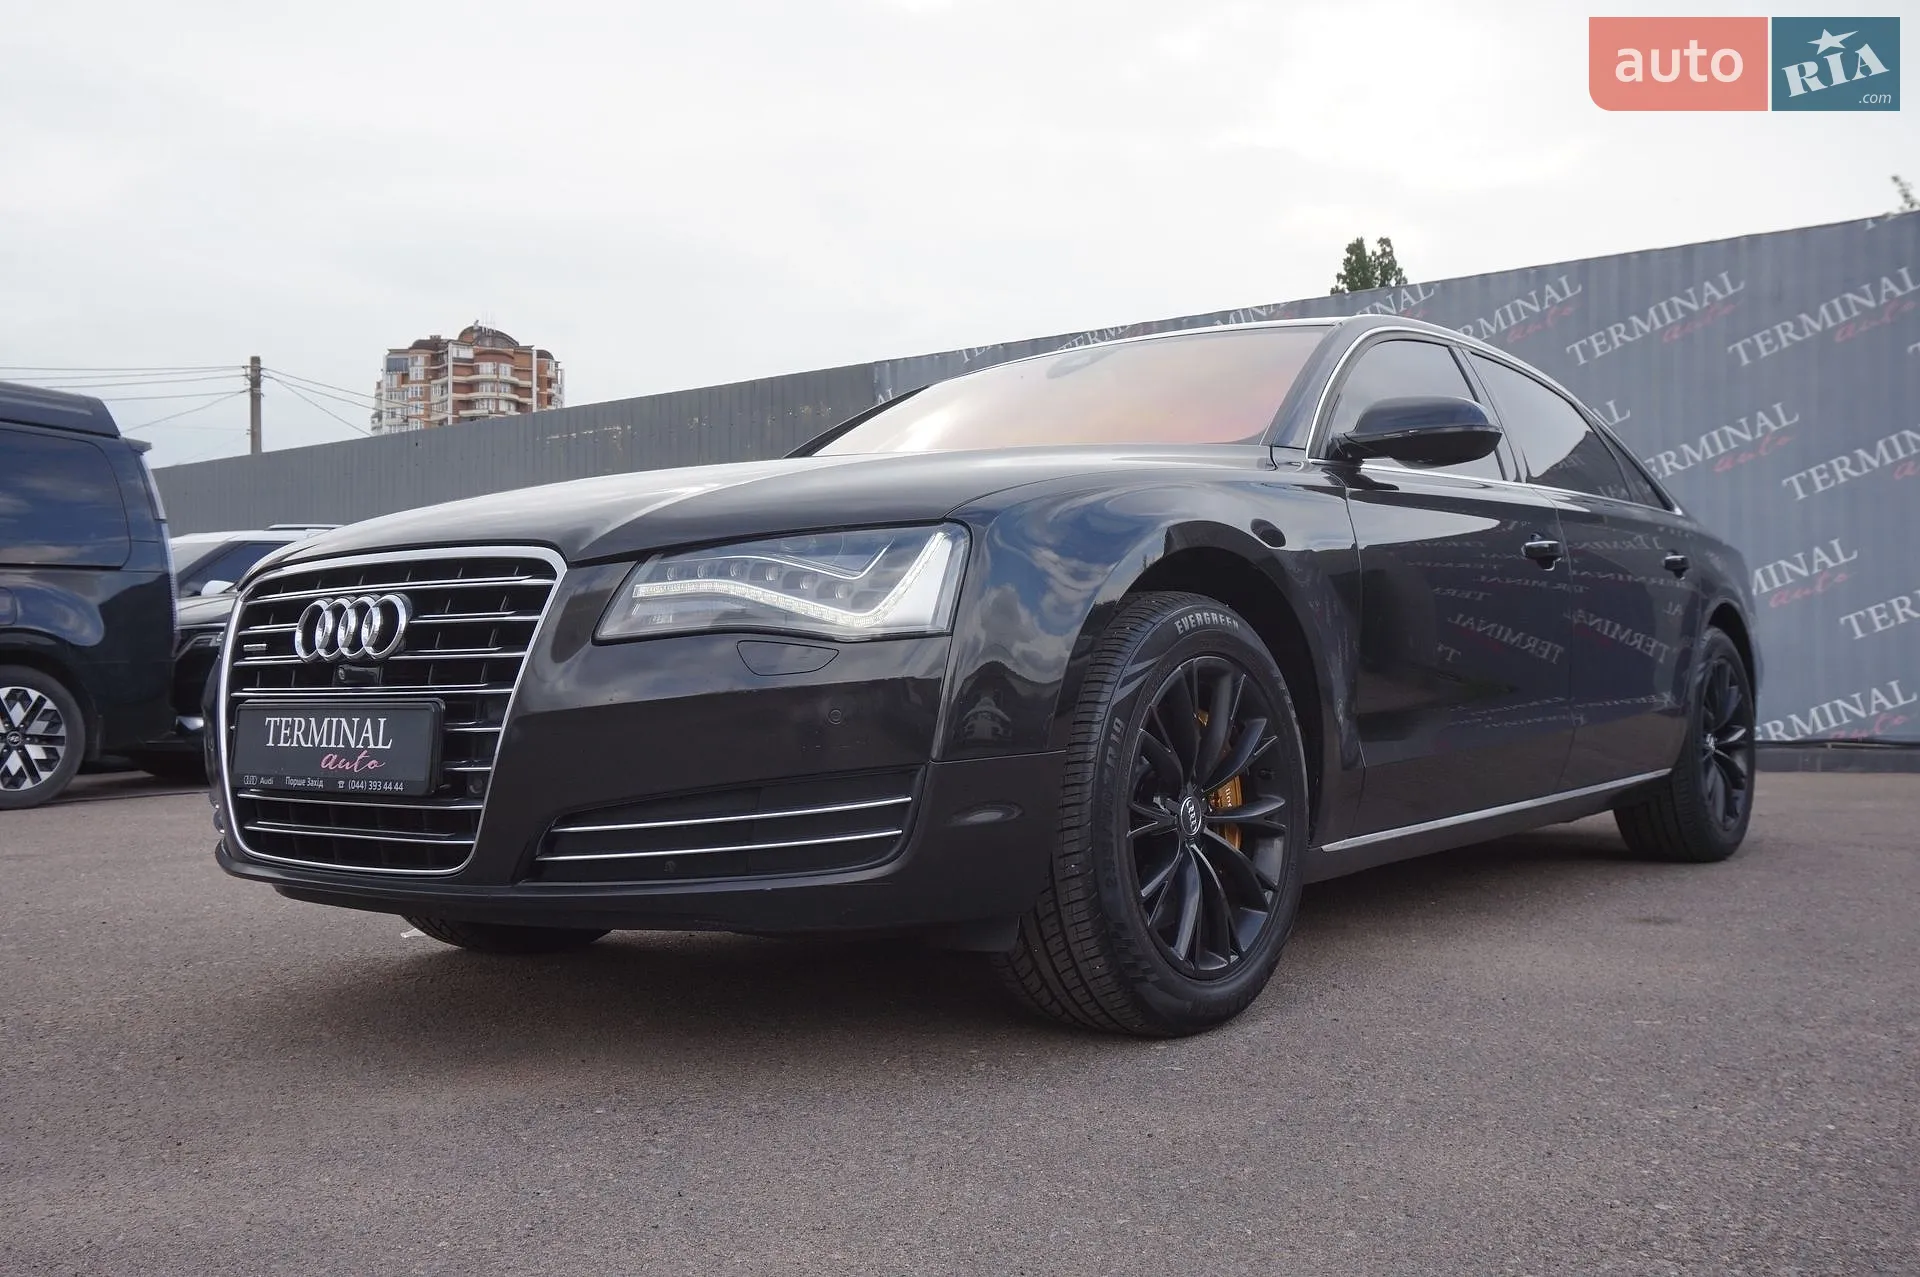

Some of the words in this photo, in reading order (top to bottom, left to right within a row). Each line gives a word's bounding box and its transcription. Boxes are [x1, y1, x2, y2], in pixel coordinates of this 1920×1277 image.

[1566, 270, 1745, 366] TERMINAL
[1727, 266, 1920, 367] TERMINAL
[1174, 612, 1239, 635] EVERGREEN
[264, 717, 393, 750] TERMINAL
[320, 750, 386, 773] auto
[260, 776, 274, 785] Audi
[348, 780, 367, 791] (044)
[368, 780, 382, 791] 393
[383, 781, 393, 792] 44
[393, 781, 404, 792] 44
